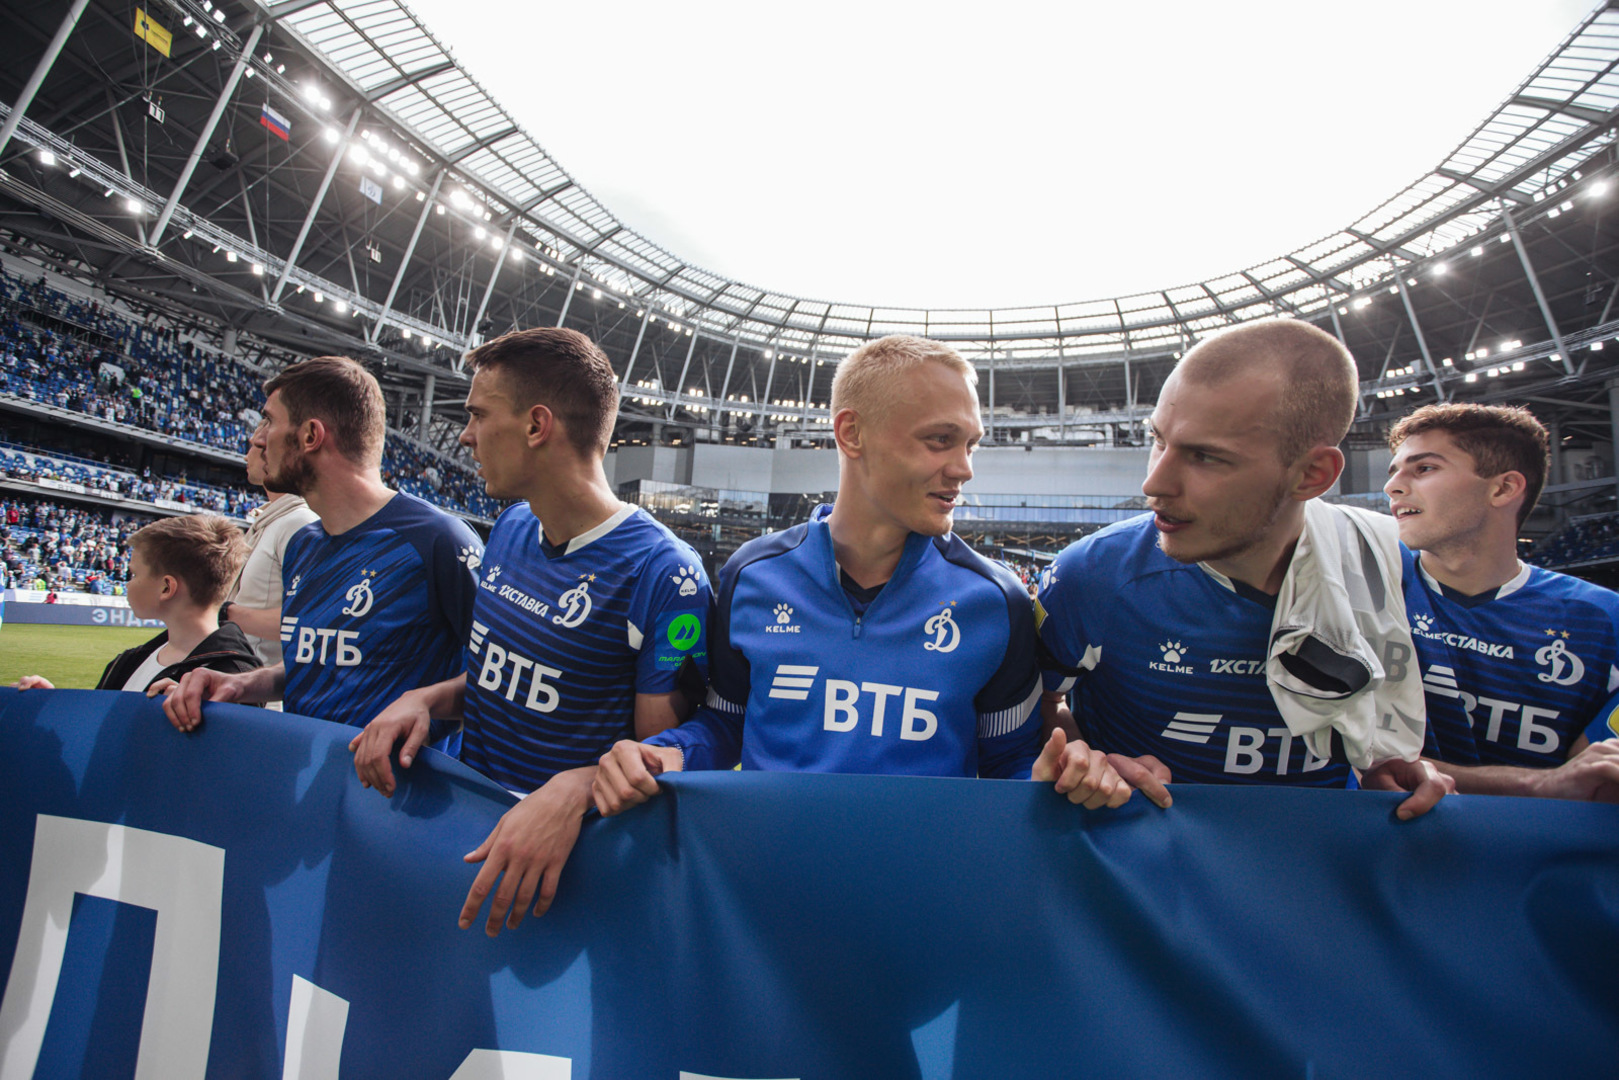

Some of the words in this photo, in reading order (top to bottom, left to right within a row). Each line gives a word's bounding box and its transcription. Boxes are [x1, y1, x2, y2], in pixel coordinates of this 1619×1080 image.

[765, 625, 801, 633] KELME
[1410, 626, 1442, 640] ELME
[295, 626, 362, 667] ВТБ
[1441, 631, 1514, 660] СТАВКА
[477, 642, 563, 713] ВТБ
[1149, 661, 1194, 675] KELME
[823, 679, 940, 742] ВТБ
